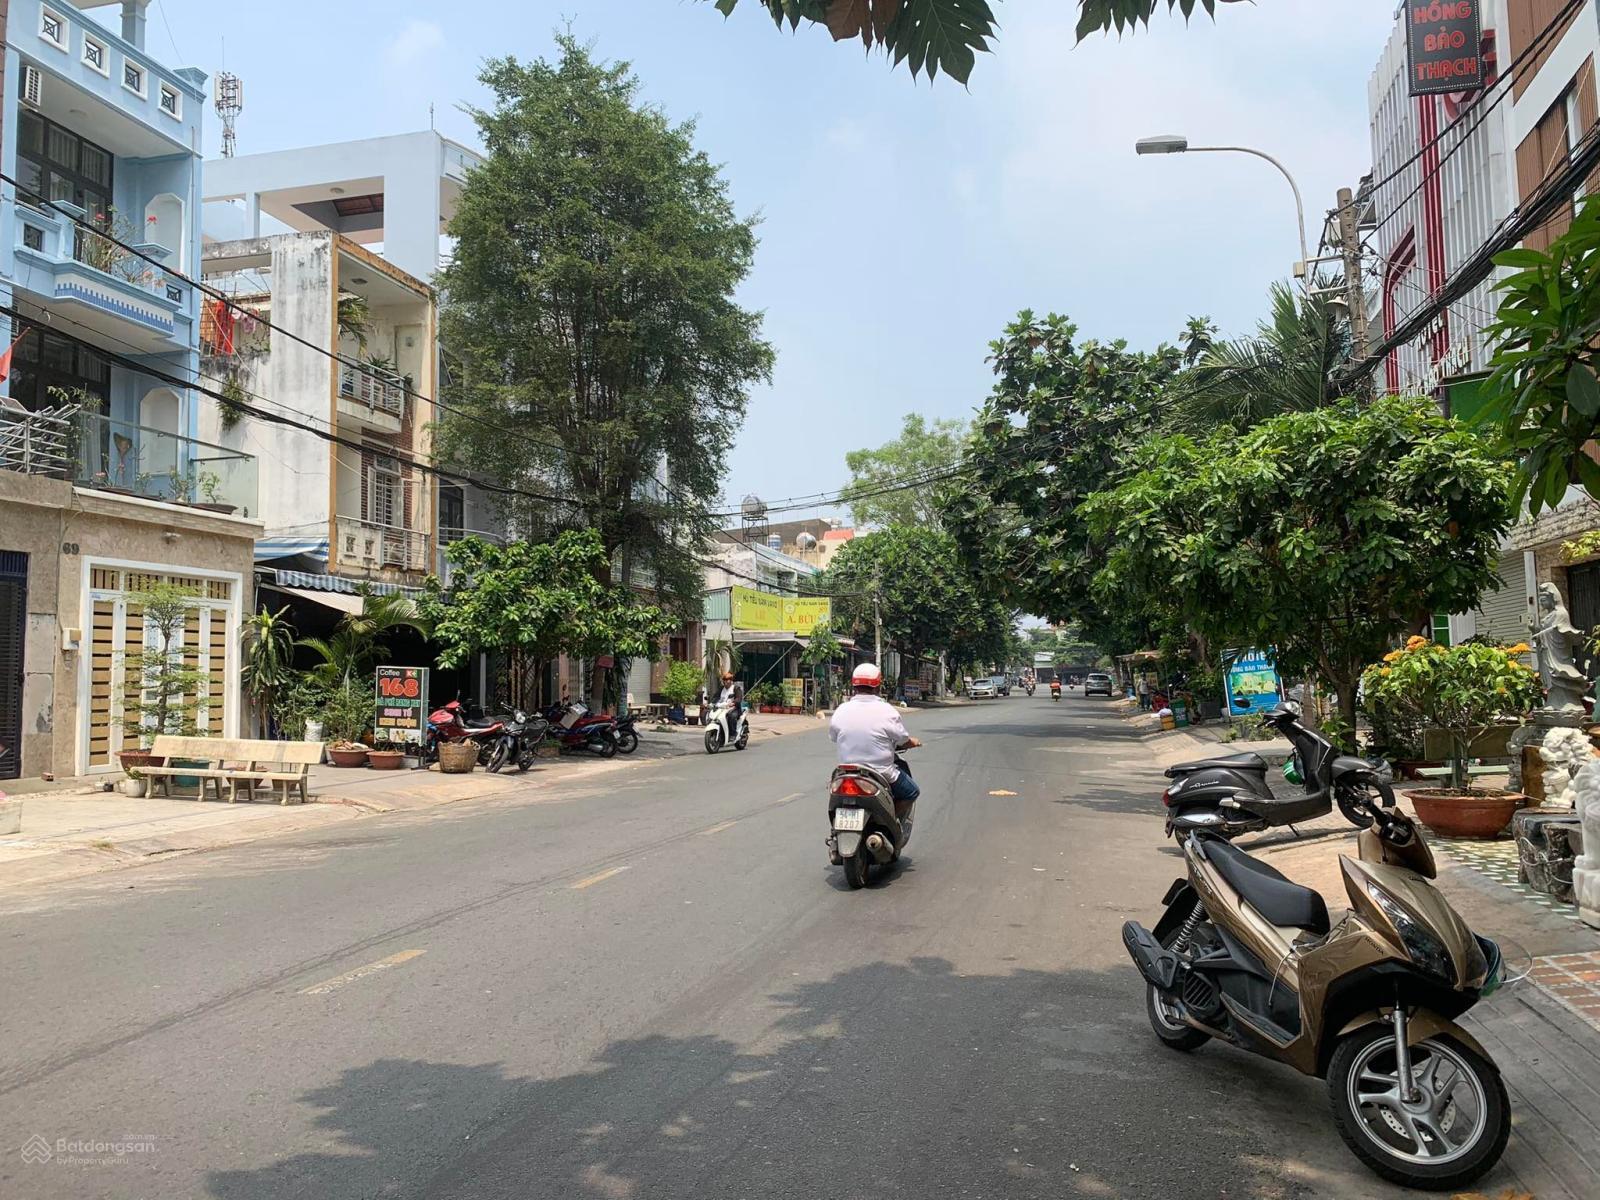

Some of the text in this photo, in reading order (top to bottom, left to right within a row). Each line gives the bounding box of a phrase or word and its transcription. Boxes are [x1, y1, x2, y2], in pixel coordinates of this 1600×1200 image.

[1424, 26, 1465, 52] BẢO
[1415, 57, 1477, 81] THẠCH
[63, 542, 80, 555] 69
[380, 677, 418, 697] 168
